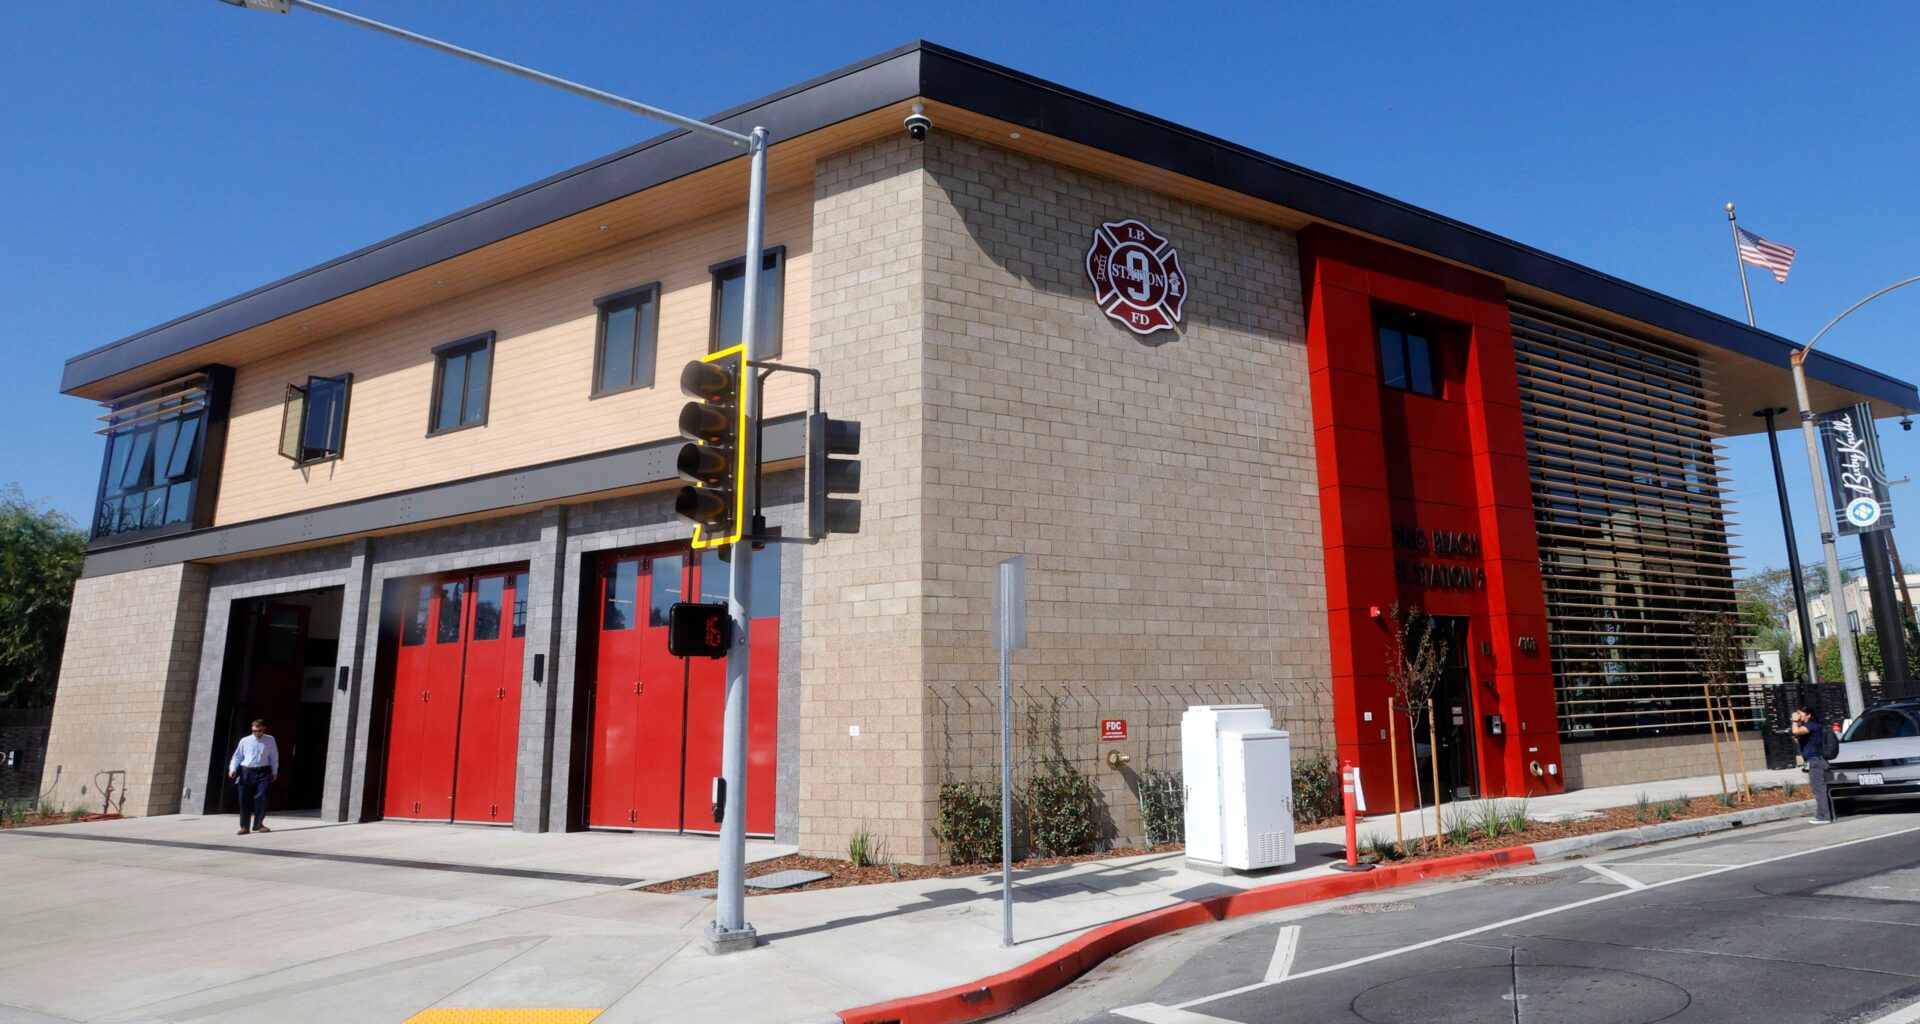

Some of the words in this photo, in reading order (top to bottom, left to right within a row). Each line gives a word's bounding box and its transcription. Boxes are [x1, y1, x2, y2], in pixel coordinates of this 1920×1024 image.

[1128, 227, 1145, 241] LB
[1126, 250, 1150, 302] 9
[1131, 311, 1149, 325] FD
[1832, 413, 1869, 468] Knolls
[1841, 453, 1873, 494] Bixby
[1431, 529, 1479, 555] BEACH
[1416, 562, 1473, 588] STATION
[1475, 565, 1484, 588] 9
[1106, 721, 1122, 731] FDC
